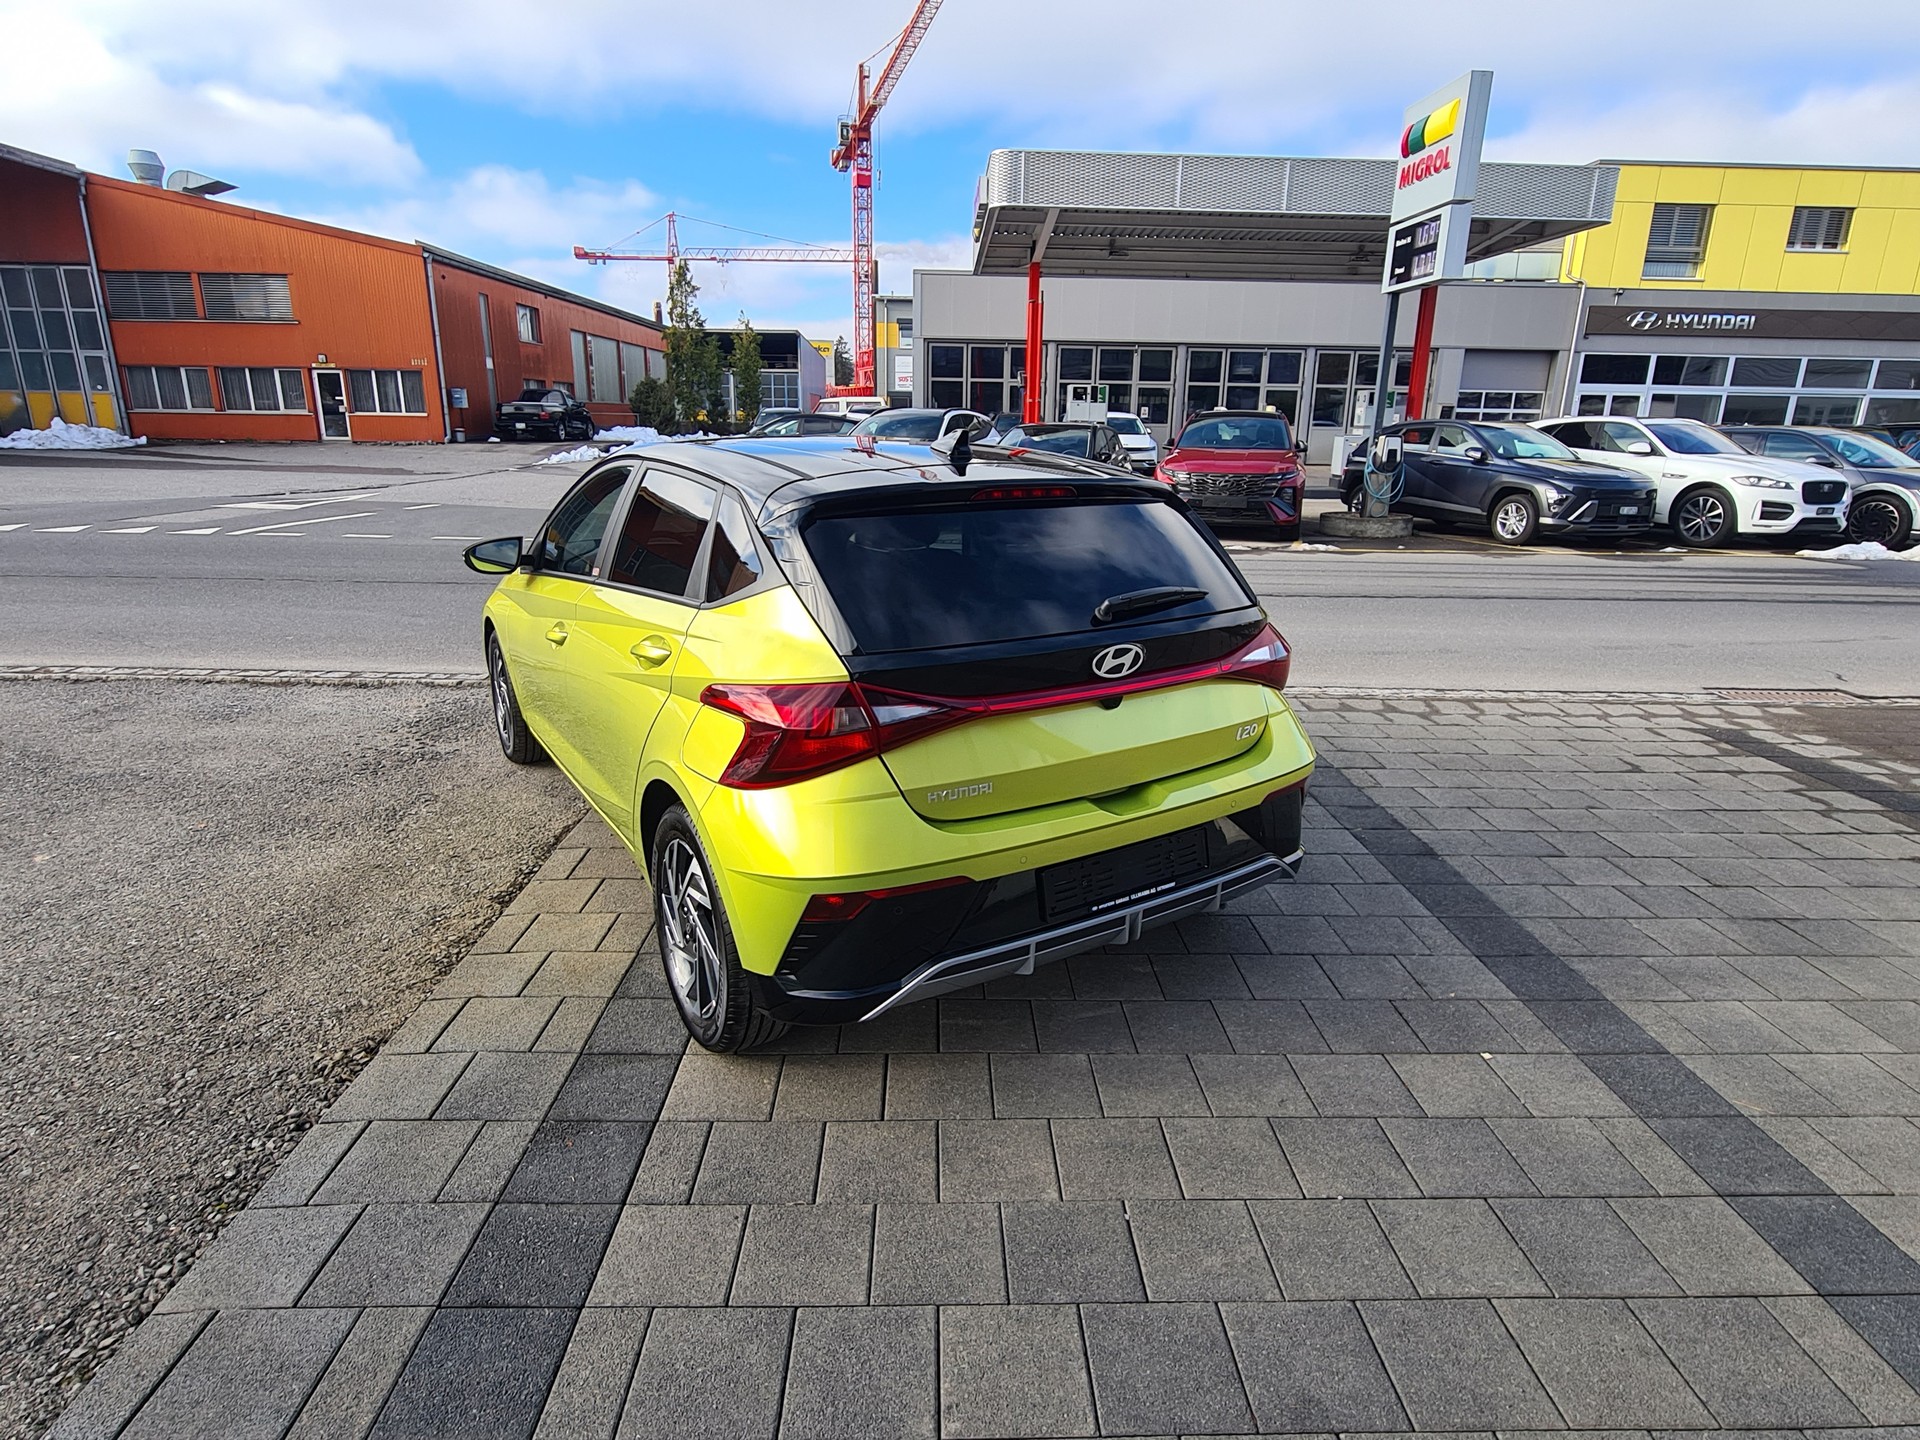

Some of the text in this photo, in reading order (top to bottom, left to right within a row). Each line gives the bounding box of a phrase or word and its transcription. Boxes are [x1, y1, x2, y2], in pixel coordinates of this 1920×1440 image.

[1398, 145, 1451, 190] MIGROL
[1665, 313, 1757, 330] HYUNDAI
[927, 782, 993, 803] HYUNDAI
